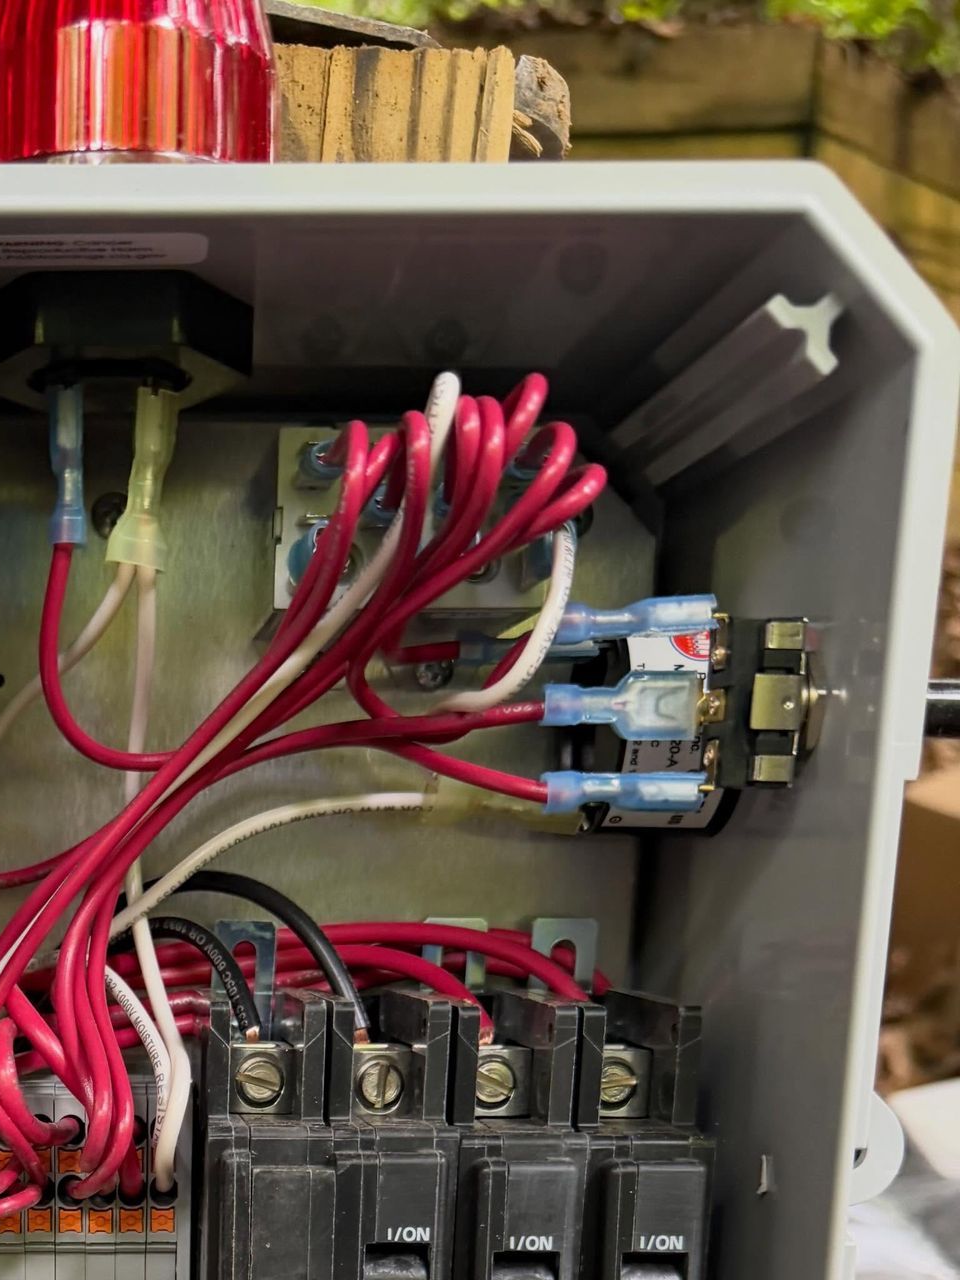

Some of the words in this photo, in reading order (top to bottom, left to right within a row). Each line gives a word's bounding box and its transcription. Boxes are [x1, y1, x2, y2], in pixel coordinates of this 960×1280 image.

[188, 930, 207, 946] OR
[134, 1016, 162, 1070] MOISTURE
[386, 1226, 431, 1242] I/ON
[509, 1235, 553, 1251] I/ON
[639, 1235, 684, 1251] I/ON
